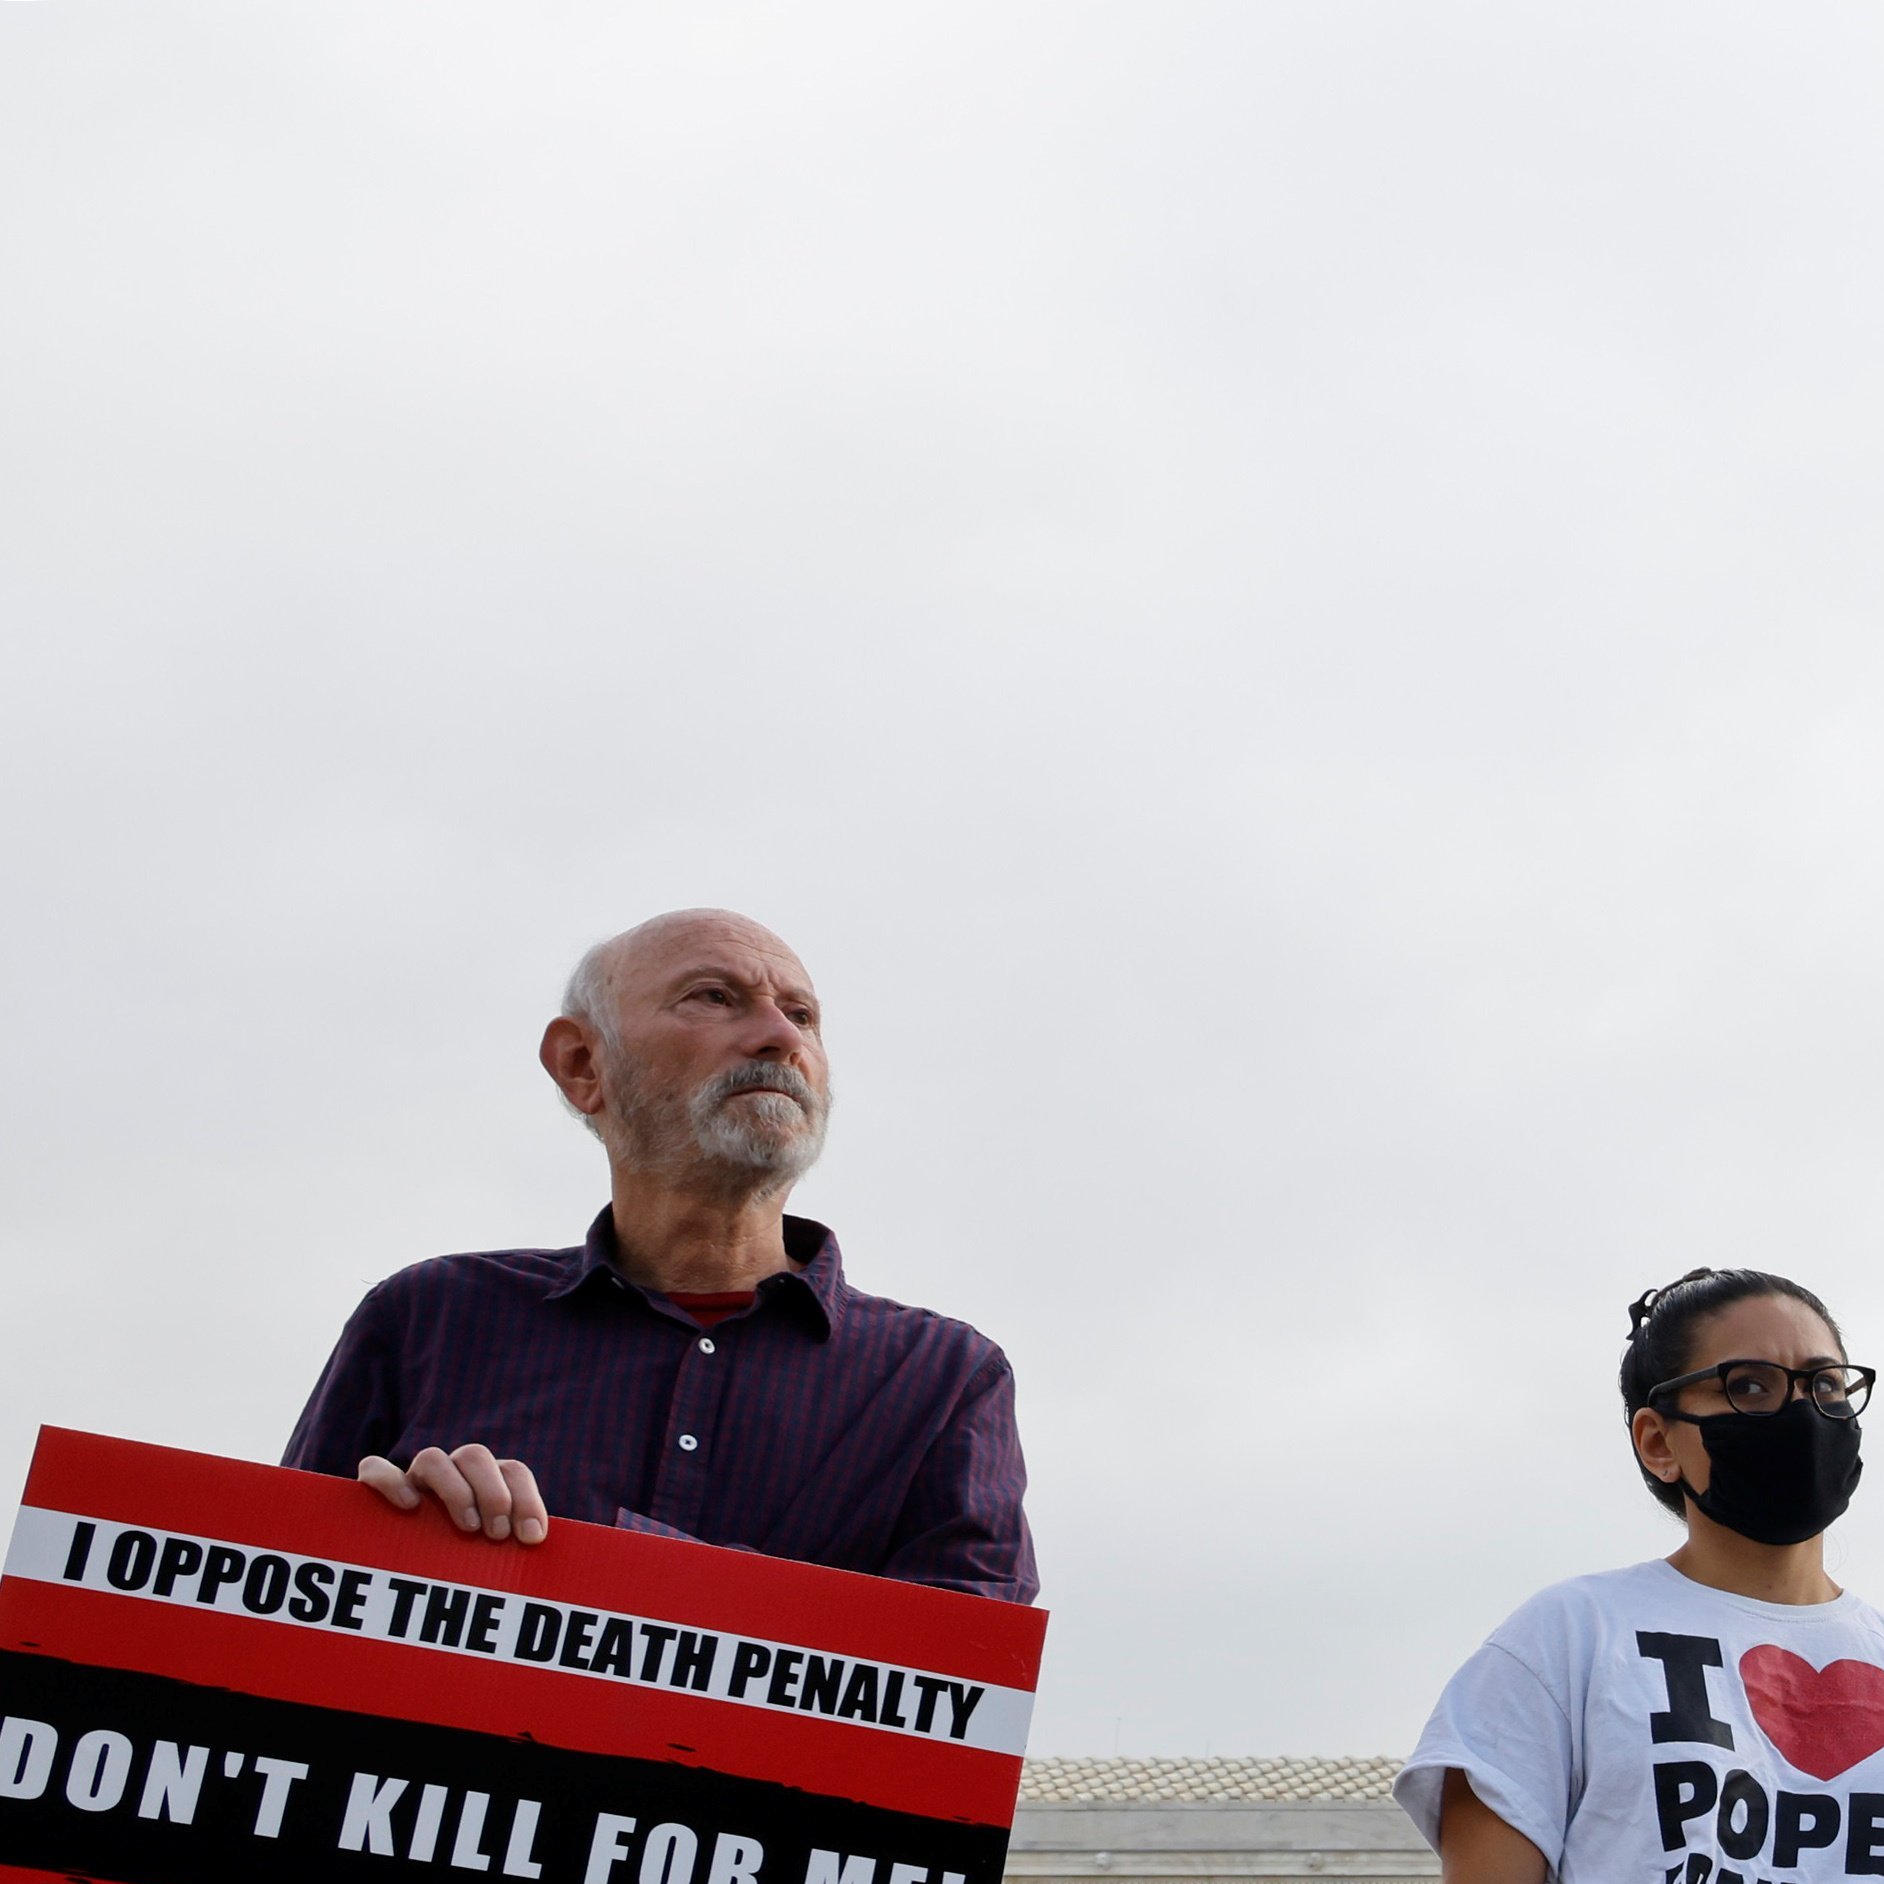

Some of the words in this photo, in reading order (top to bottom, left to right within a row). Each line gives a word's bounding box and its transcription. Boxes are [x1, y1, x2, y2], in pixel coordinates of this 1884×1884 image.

[64, 1522, 95, 1580] I
[108, 1530, 371, 1629] OPPOSE
[388, 1579, 505, 1654] THE
[514, 1603, 718, 1692] DEATH
[726, 1646, 984, 1740] PENALTY
[1635, 1630, 1736, 1752] I
[1, 1716, 309, 1838] DON'T
[337, 1773, 543, 1879] KILL
